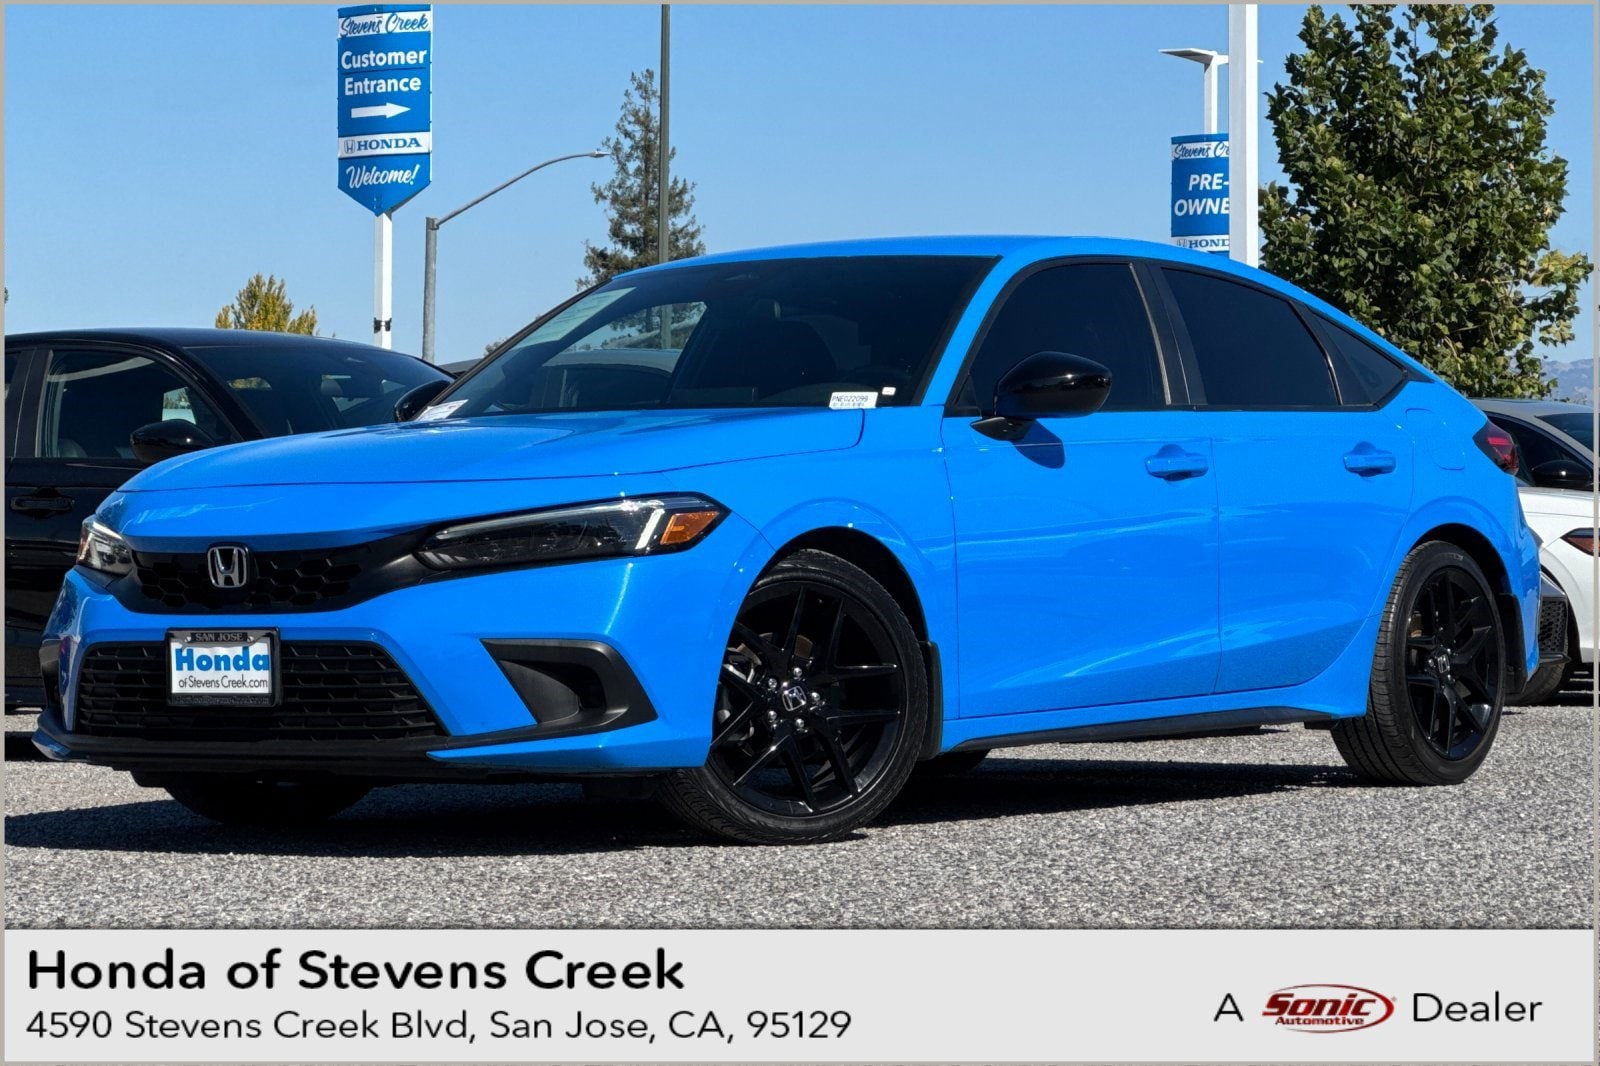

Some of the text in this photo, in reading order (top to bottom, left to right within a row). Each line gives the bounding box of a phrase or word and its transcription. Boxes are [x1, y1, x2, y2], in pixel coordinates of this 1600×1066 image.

[340, 12, 429, 37] Stevens Creek
[341, 50, 427, 69] Customer
[344, 77, 422, 96] Entrance
[357, 137, 422, 151] HONDA
[1173, 143, 1211, 159] Stevens
[346, 164, 420, 189] Welcome!
[1188, 173, 1229, 191] PRE-
[1174, 197, 1229, 216] OWNE
[1189, 239, 1229, 248] HOND
[195, 632, 244, 641] SAN JOSE
[175, 646, 270, 671] Honda
